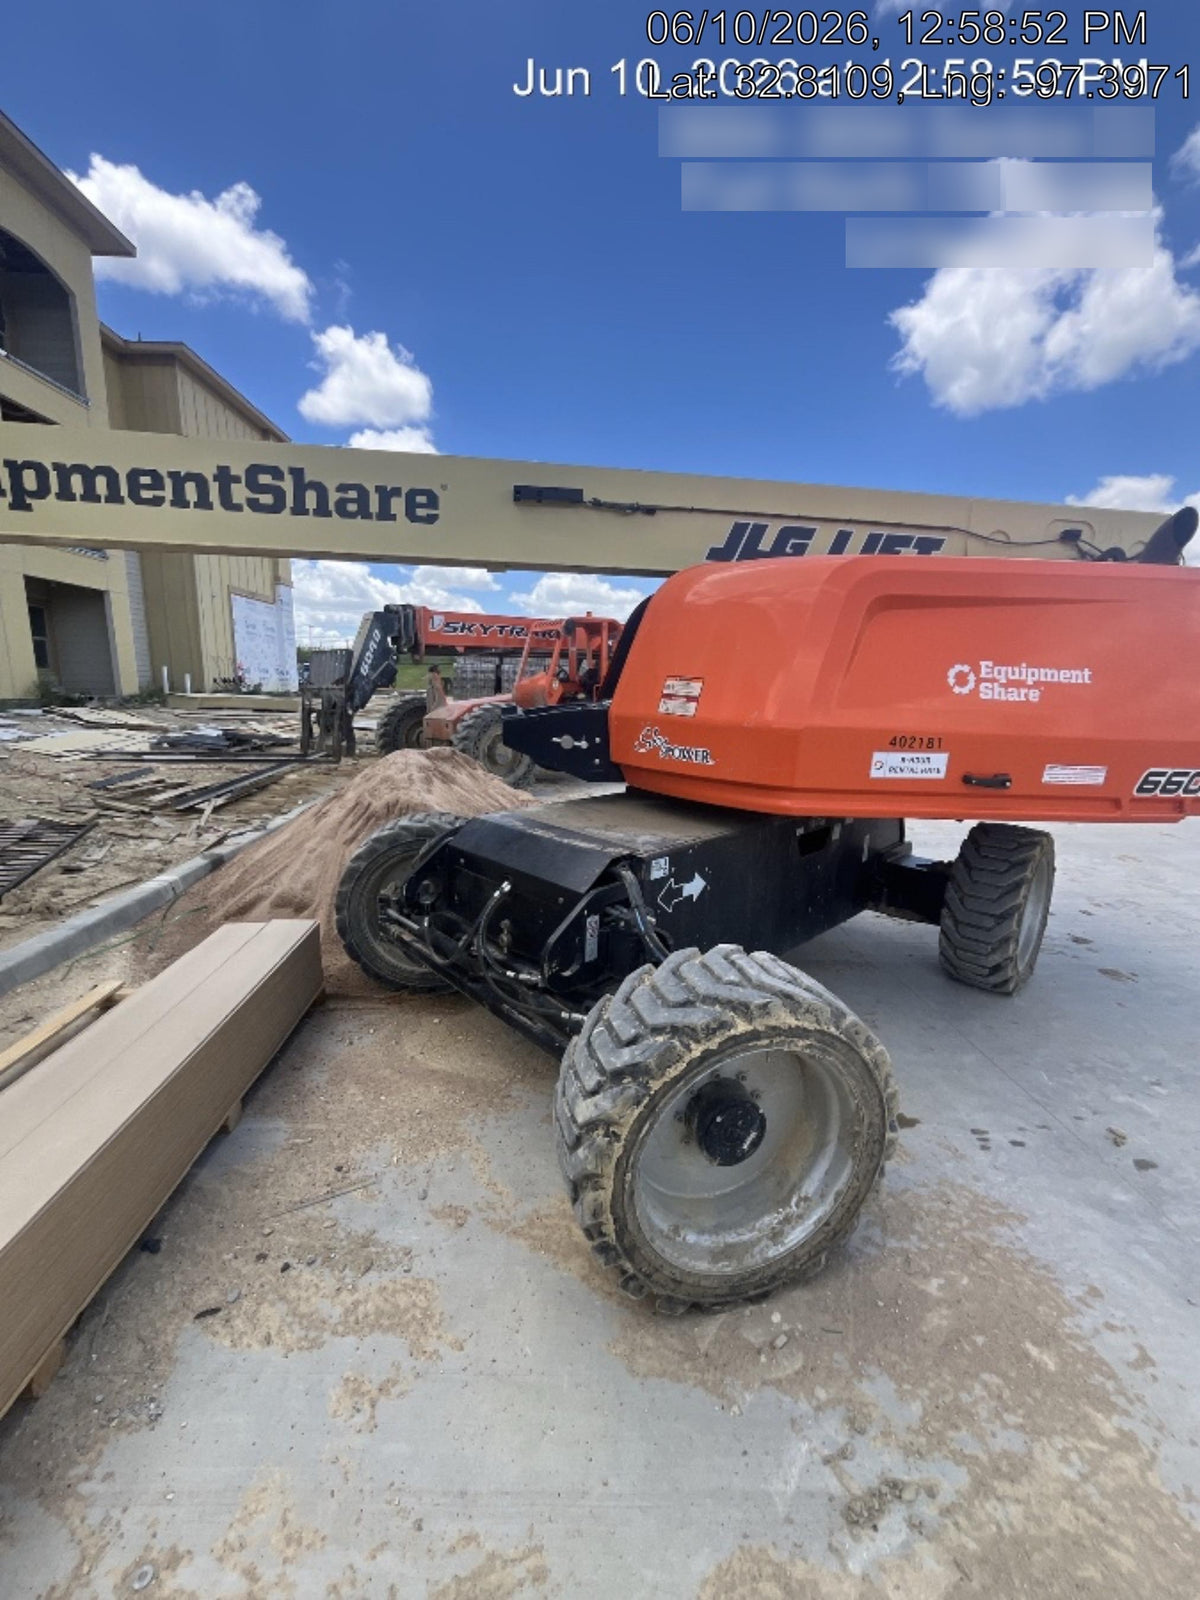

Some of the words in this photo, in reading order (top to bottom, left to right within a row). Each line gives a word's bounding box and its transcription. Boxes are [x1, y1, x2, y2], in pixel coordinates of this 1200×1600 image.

[0, 457, 440, 525] pmentShare
[705, 521, 819, 562] JLG
[979, 660, 1093, 685] Equipment
[979, 682, 1041, 702] Share
[888, 735, 944, 749] 402181
